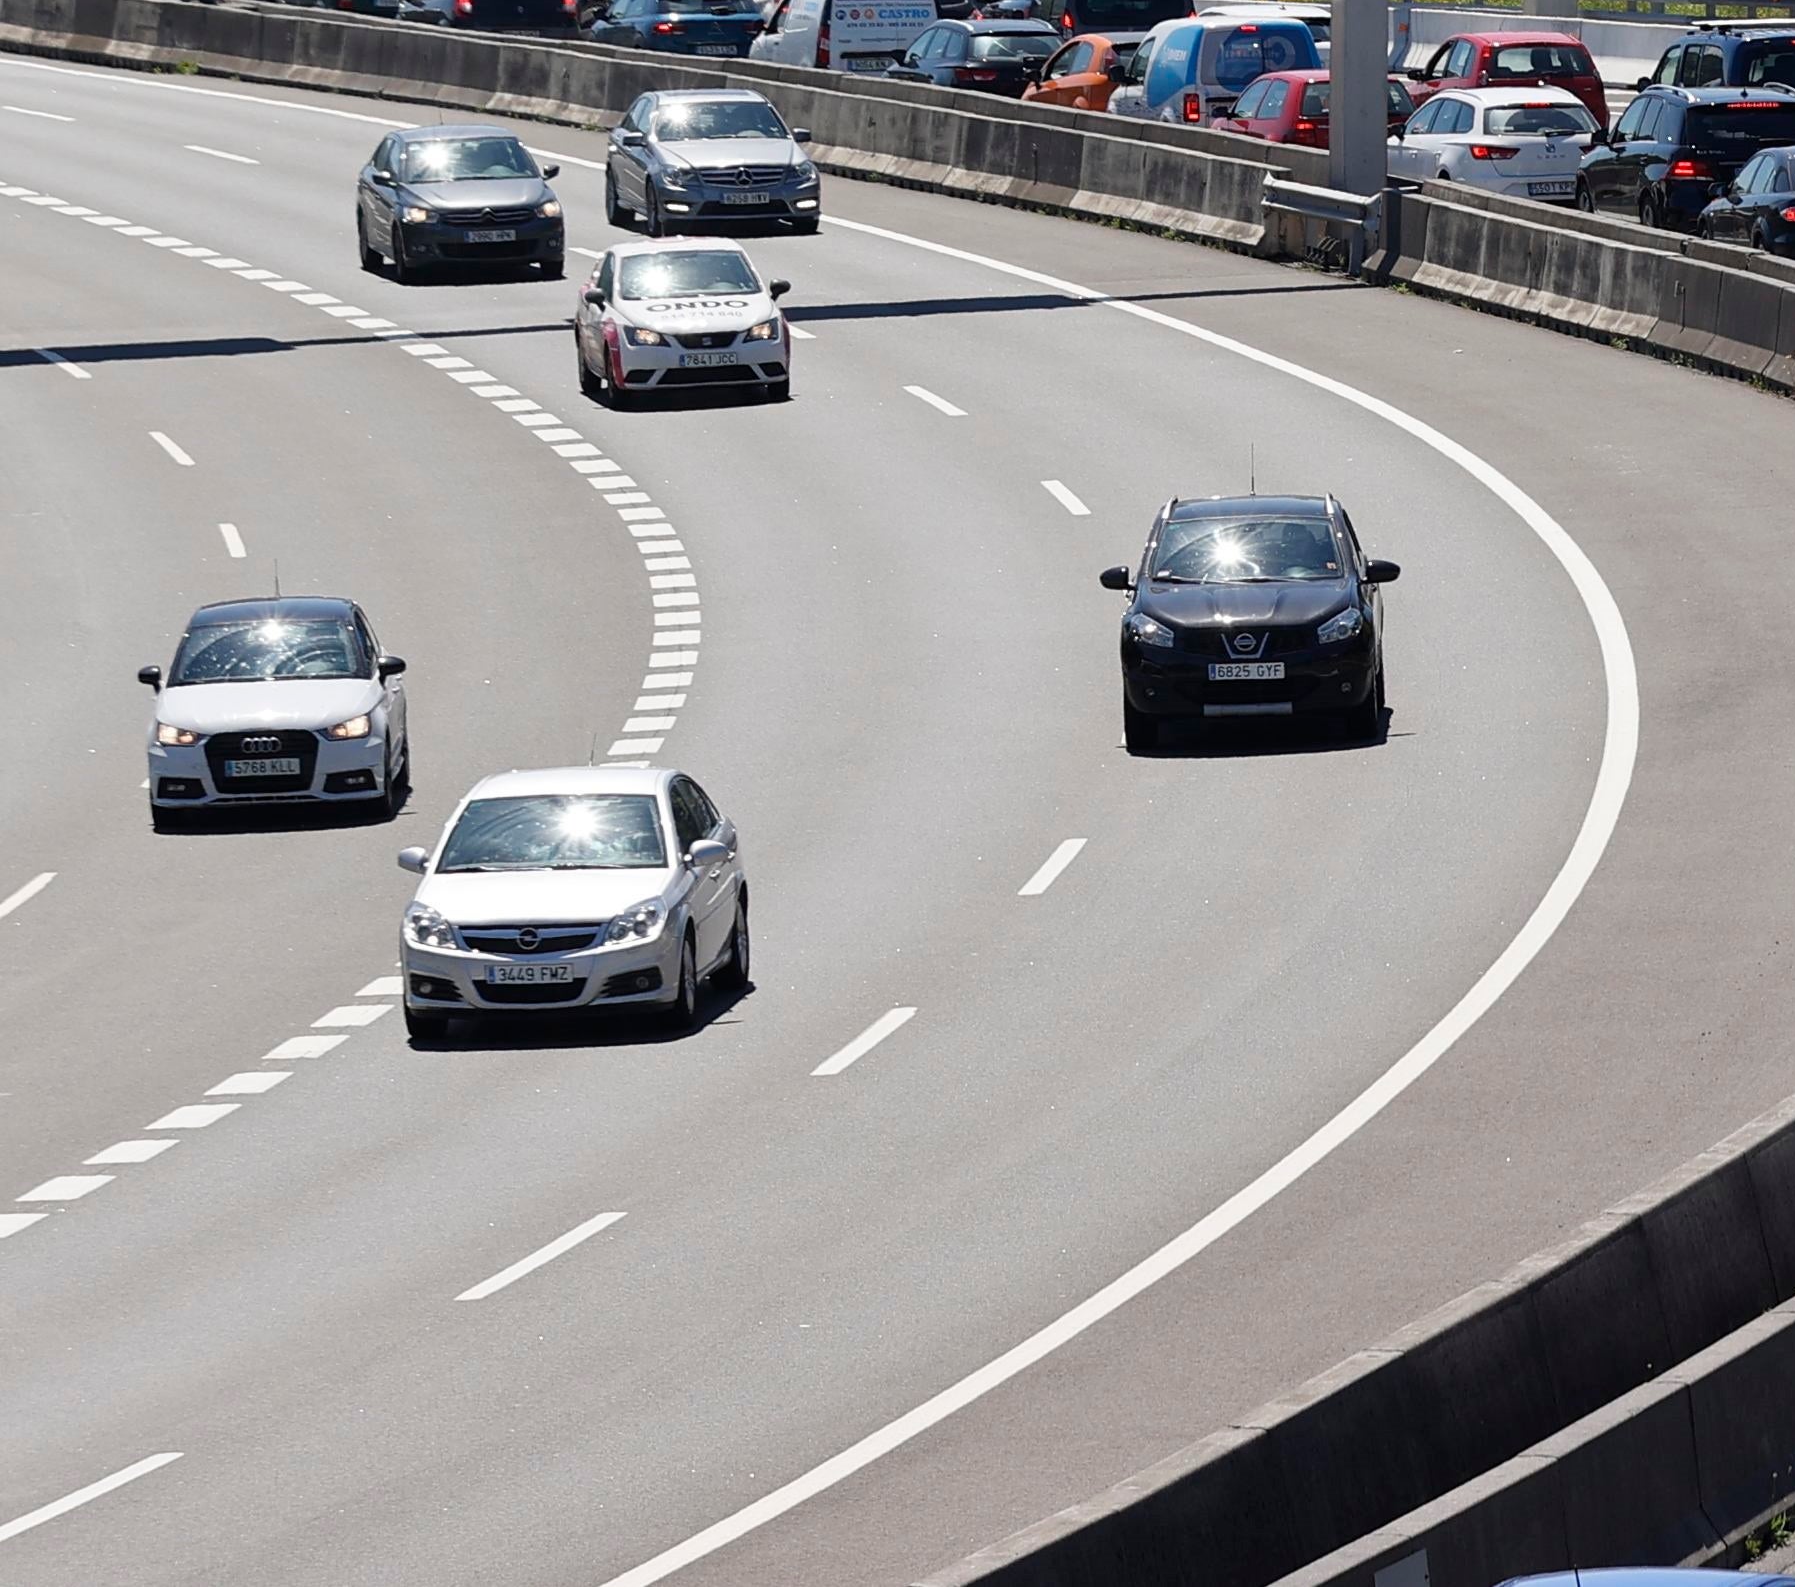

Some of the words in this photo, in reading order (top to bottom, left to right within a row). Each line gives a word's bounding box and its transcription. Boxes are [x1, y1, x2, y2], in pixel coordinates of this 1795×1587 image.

[879, 9, 930, 19] CASTRO
[646, 300, 748, 312] ONDO
[686, 353, 712, 365] 7841
[715, 353, 735, 364] JCC
[1217, 665, 1250, 678] 6825
[1257, 664, 1281, 677] GYF
[235, 759, 267, 774] 5768
[271, 759, 295, 773] KLL
[499, 967, 534, 981] 3449
[541, 966, 568, 981] FMZ
